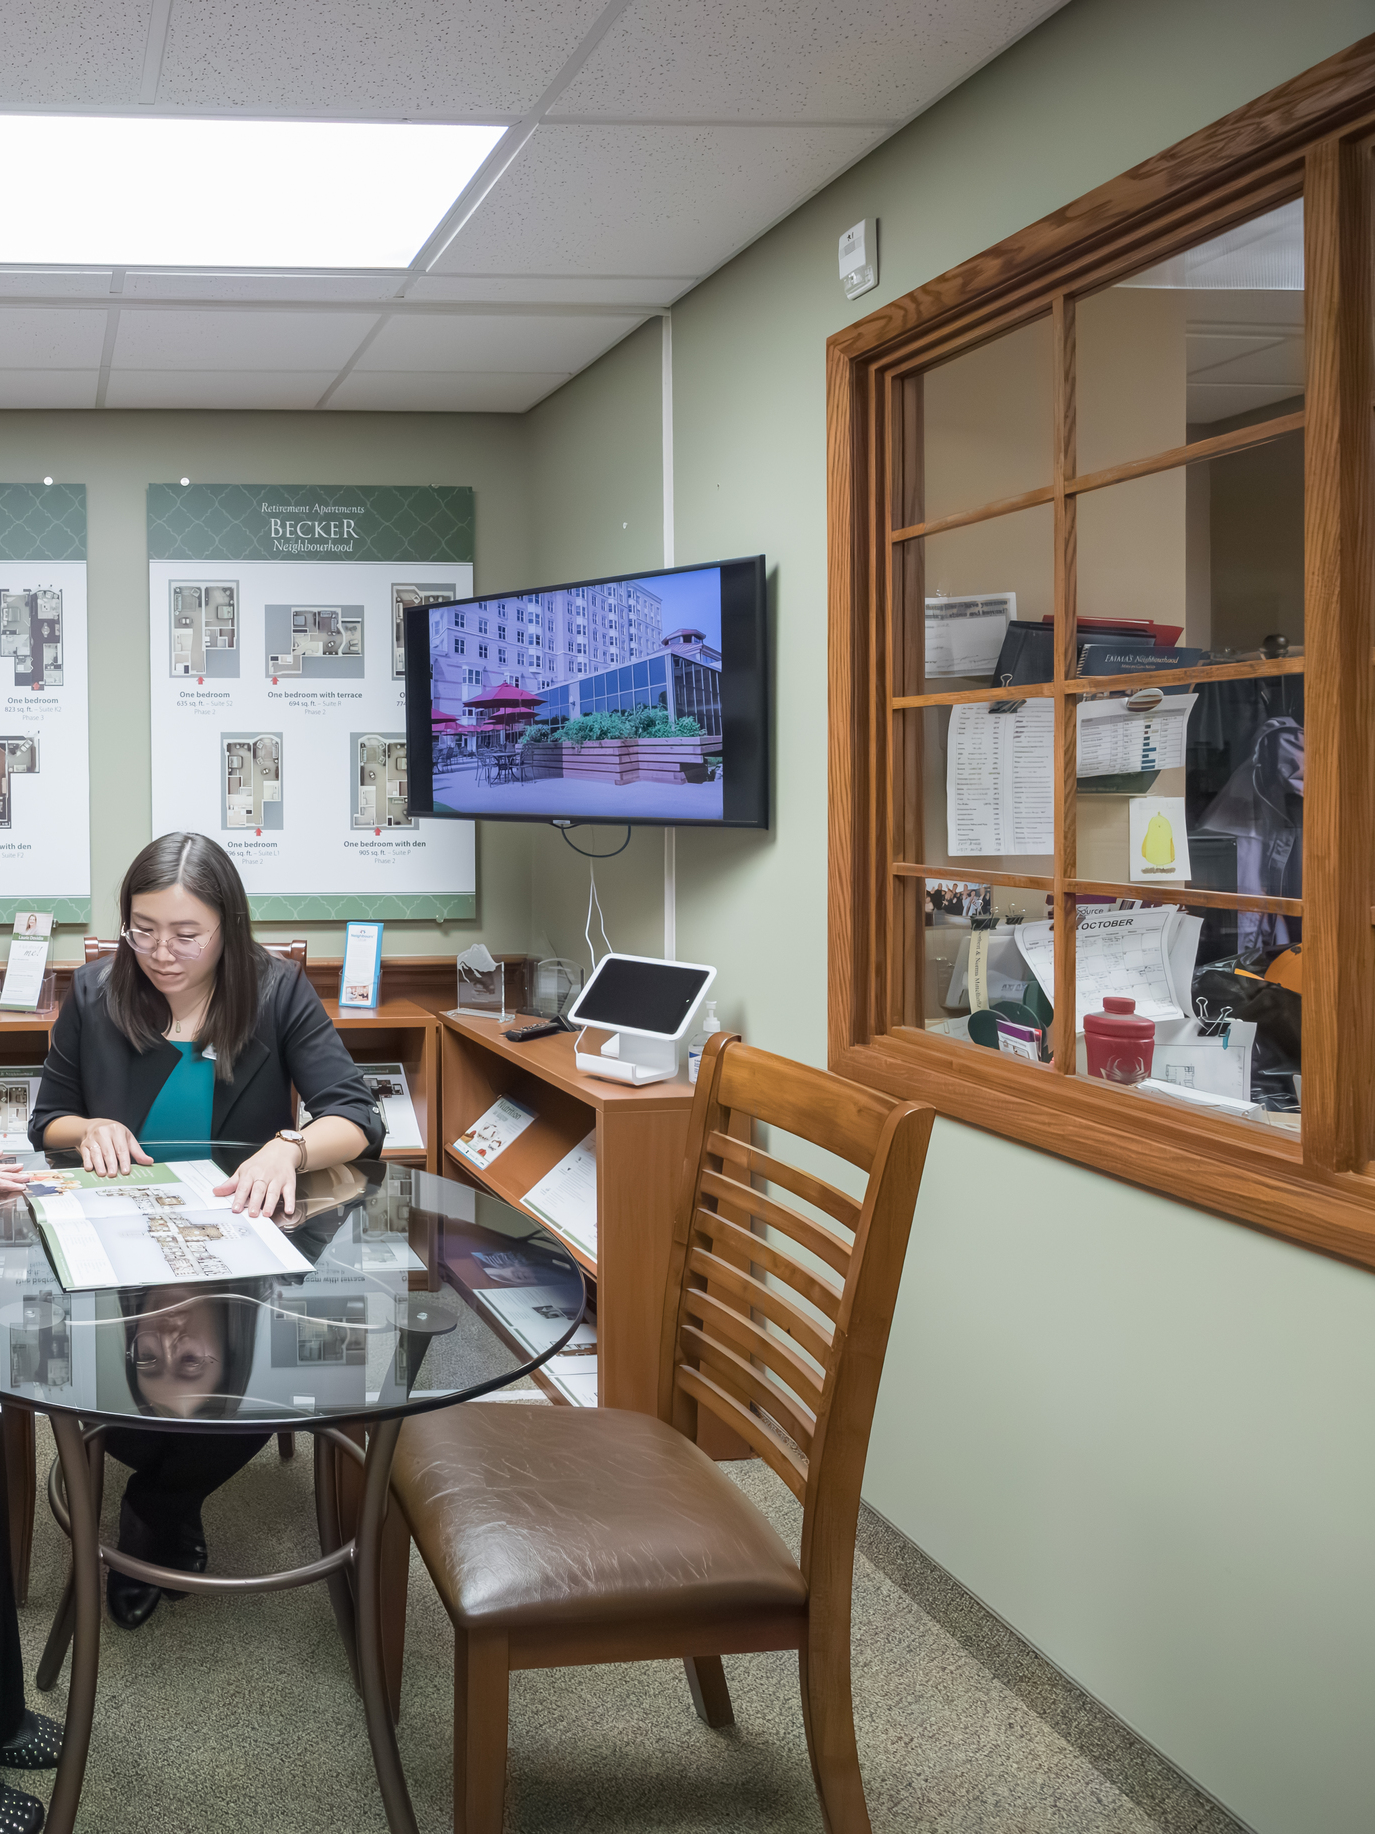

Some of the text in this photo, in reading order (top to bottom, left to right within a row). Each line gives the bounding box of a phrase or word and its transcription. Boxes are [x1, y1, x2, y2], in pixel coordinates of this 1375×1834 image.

[261, 502, 365, 515] Retirement Apartments
[269, 518, 360, 539] BECKER
[273, 539, 354, 554] Neighbourhood
[24, 696, 59, 704] bedroom
[267, 691, 283, 699] One
[284, 691, 317, 699] bedroom
[319, 691, 336, 699] with
[343, 840, 359, 848] One
[360, 840, 394, 848] bedroom
[1081, 918, 1134, 931] OCTOBER
[497, 1100, 522, 1120] Nutrition
